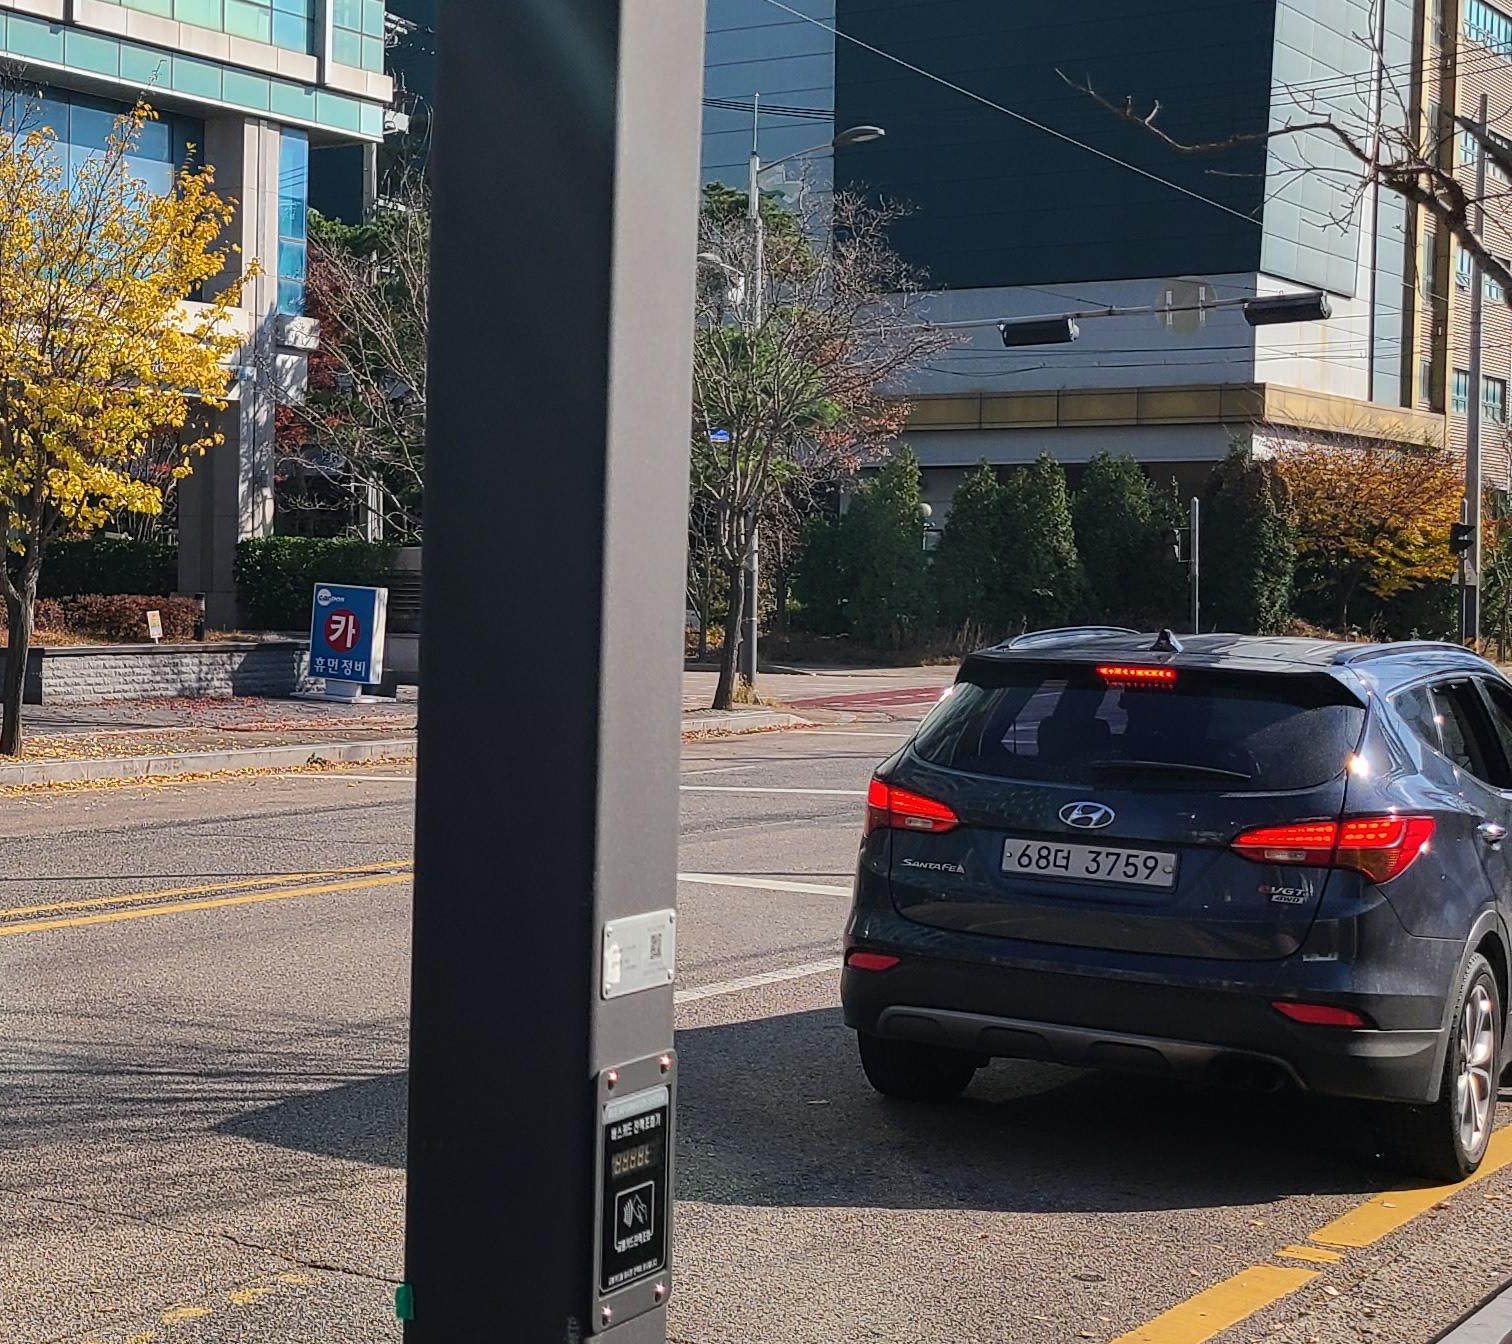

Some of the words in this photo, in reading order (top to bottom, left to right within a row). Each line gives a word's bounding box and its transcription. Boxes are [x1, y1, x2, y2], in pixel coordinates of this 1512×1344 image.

[328, 615, 356, 648] 카
[314, 657, 367, 677] 휴먼정비
[1017, 844, 1072, 872] 68더
[1084, 850, 1159, 881] 3759
